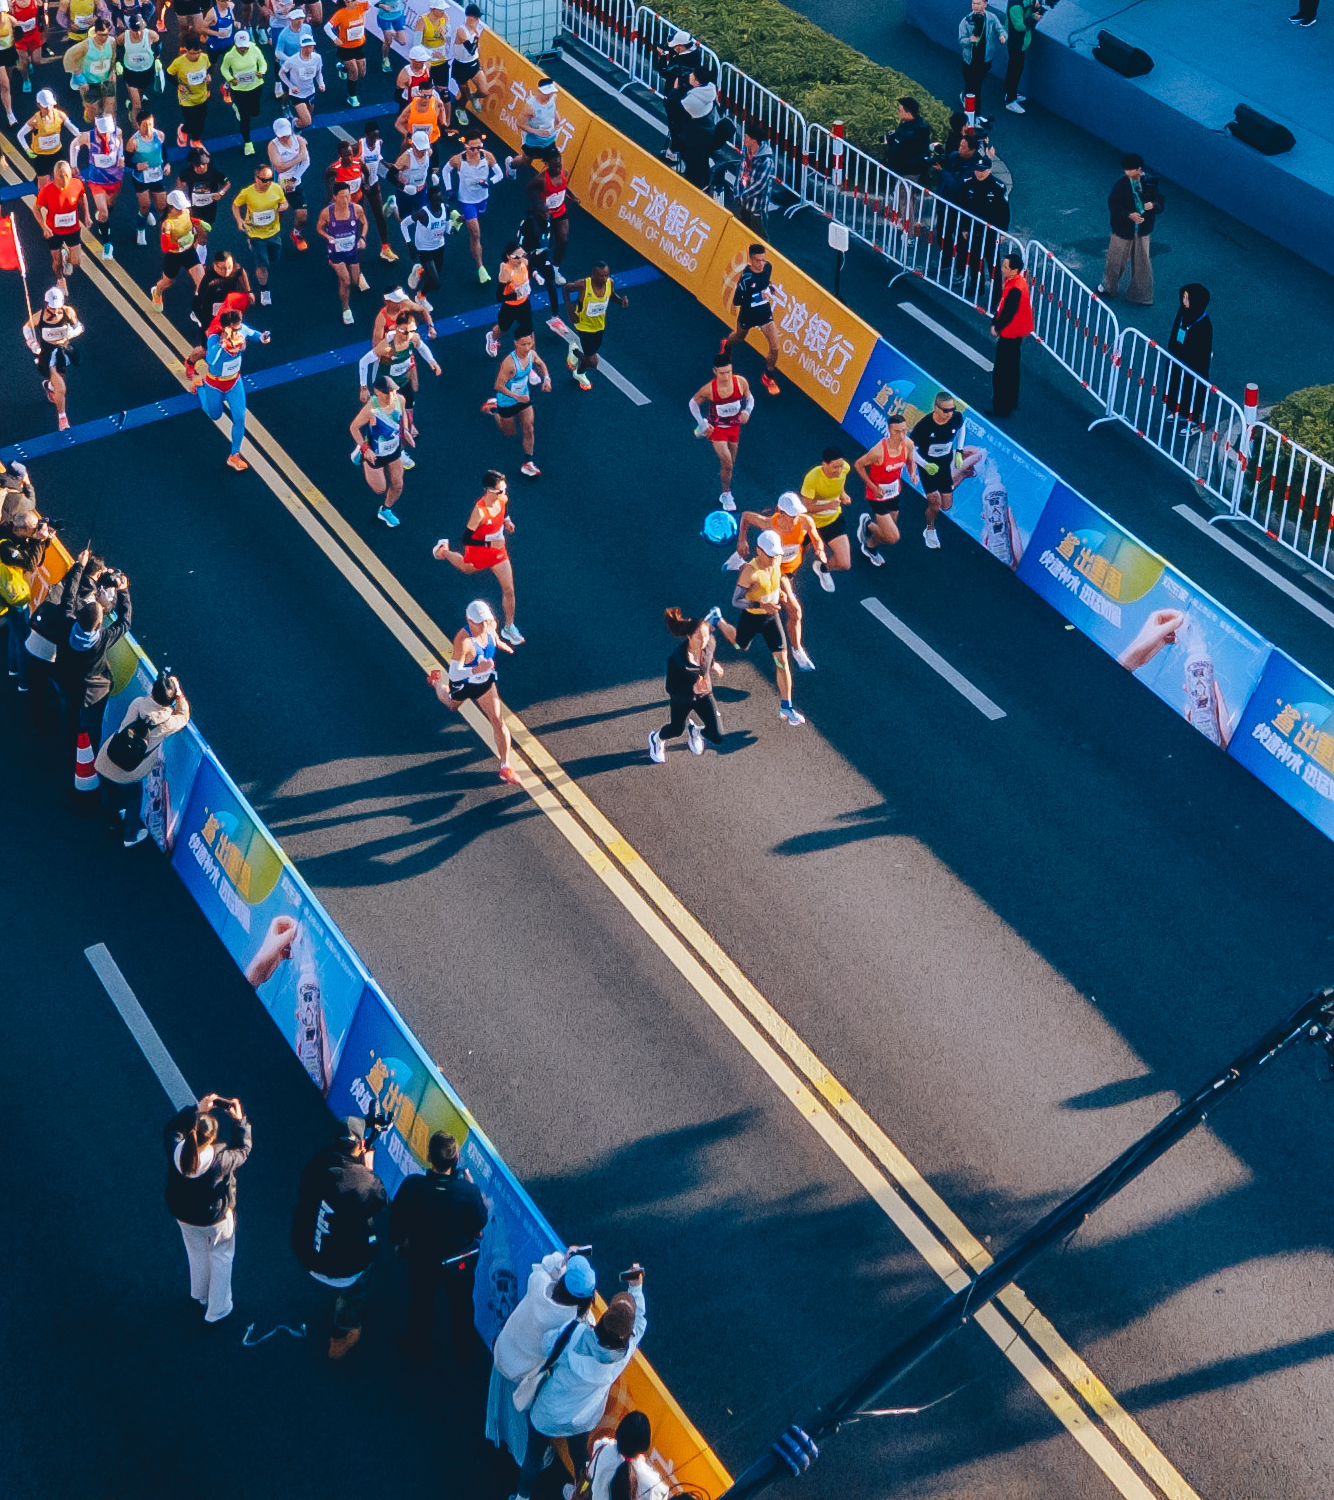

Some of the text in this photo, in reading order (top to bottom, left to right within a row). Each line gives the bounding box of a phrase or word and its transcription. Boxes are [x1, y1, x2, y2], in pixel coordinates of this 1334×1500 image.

[507, 80, 577, 154] 宁行
[617, 205, 699, 275] BANK OF NINGBO
[626, 175, 712, 257] 宁波银行
[767, 283, 857, 377] 宁波银行
[782, 338, 841, 395] OF NINGBO
[1038, 549, 1081, 596] 快速补水
[1251, 722, 1305, 776] 快速补水
